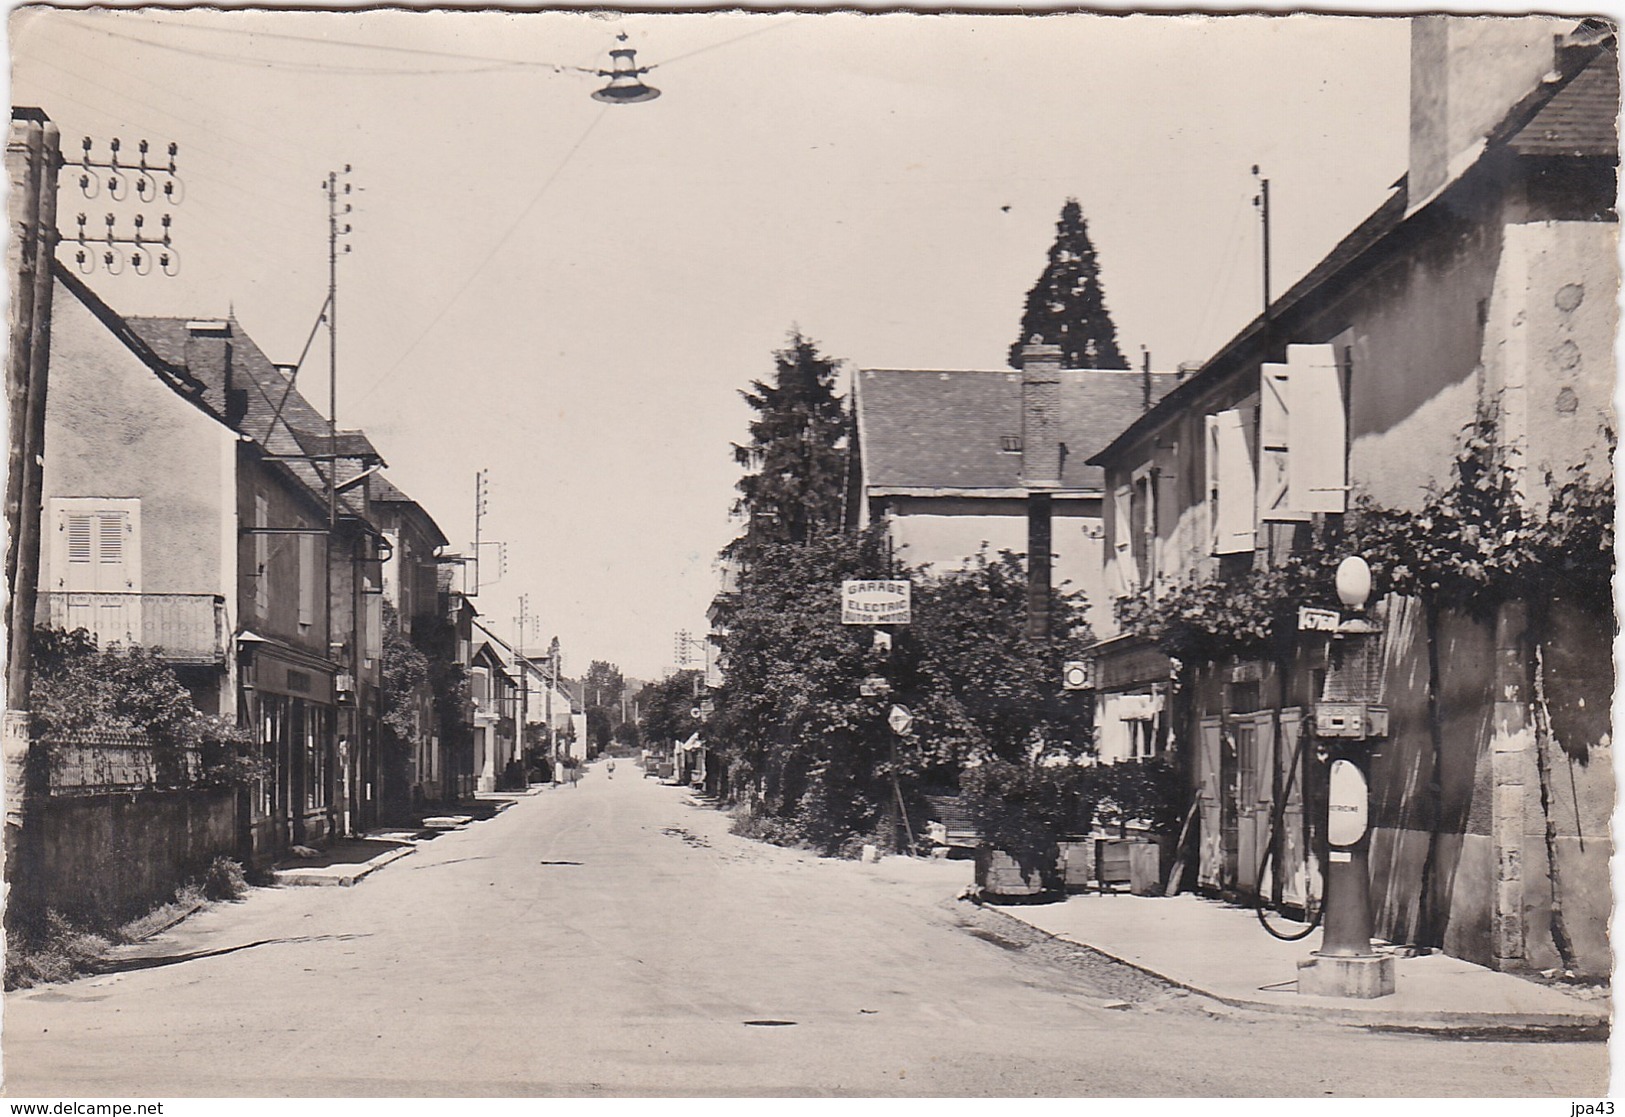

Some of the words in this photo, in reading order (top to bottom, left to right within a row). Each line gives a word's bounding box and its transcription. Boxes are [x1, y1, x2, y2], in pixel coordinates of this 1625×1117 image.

[848, 582, 905, 595] GARAGE
[848, 600, 907, 612] ELECTRIC
[878, 611, 908, 622] MOTOS
